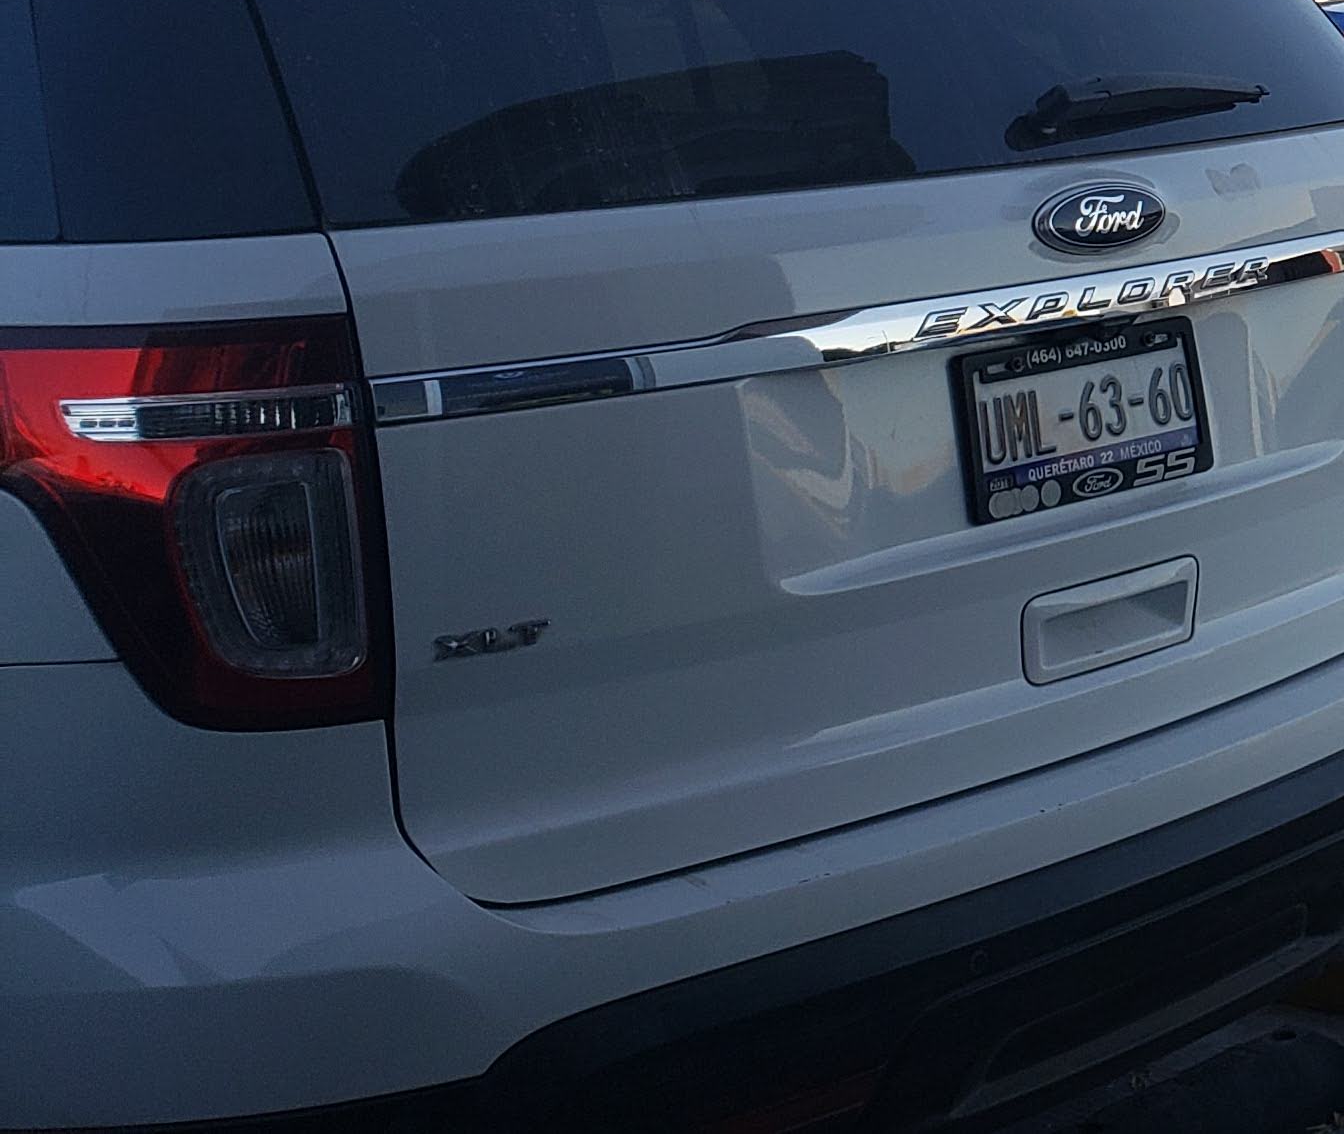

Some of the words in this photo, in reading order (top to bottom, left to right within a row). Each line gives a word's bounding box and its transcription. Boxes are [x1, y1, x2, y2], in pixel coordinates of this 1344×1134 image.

[1073, 193, 1146, 237] Ford
[913, 256, 1273, 342] EXPLORER
[1026, 346, 1062, 370] (464)
[1065, 335, 1127, 359] 647-0300
[978, 361, 1195, 465] UML-63-60
[1027, 456, 1095, 483] QUERÉTARO
[1100, 450, 1114, 464] 22
[1120, 439, 1162, 460] MÉXICO
[1083, 473, 1115, 494] Ford
